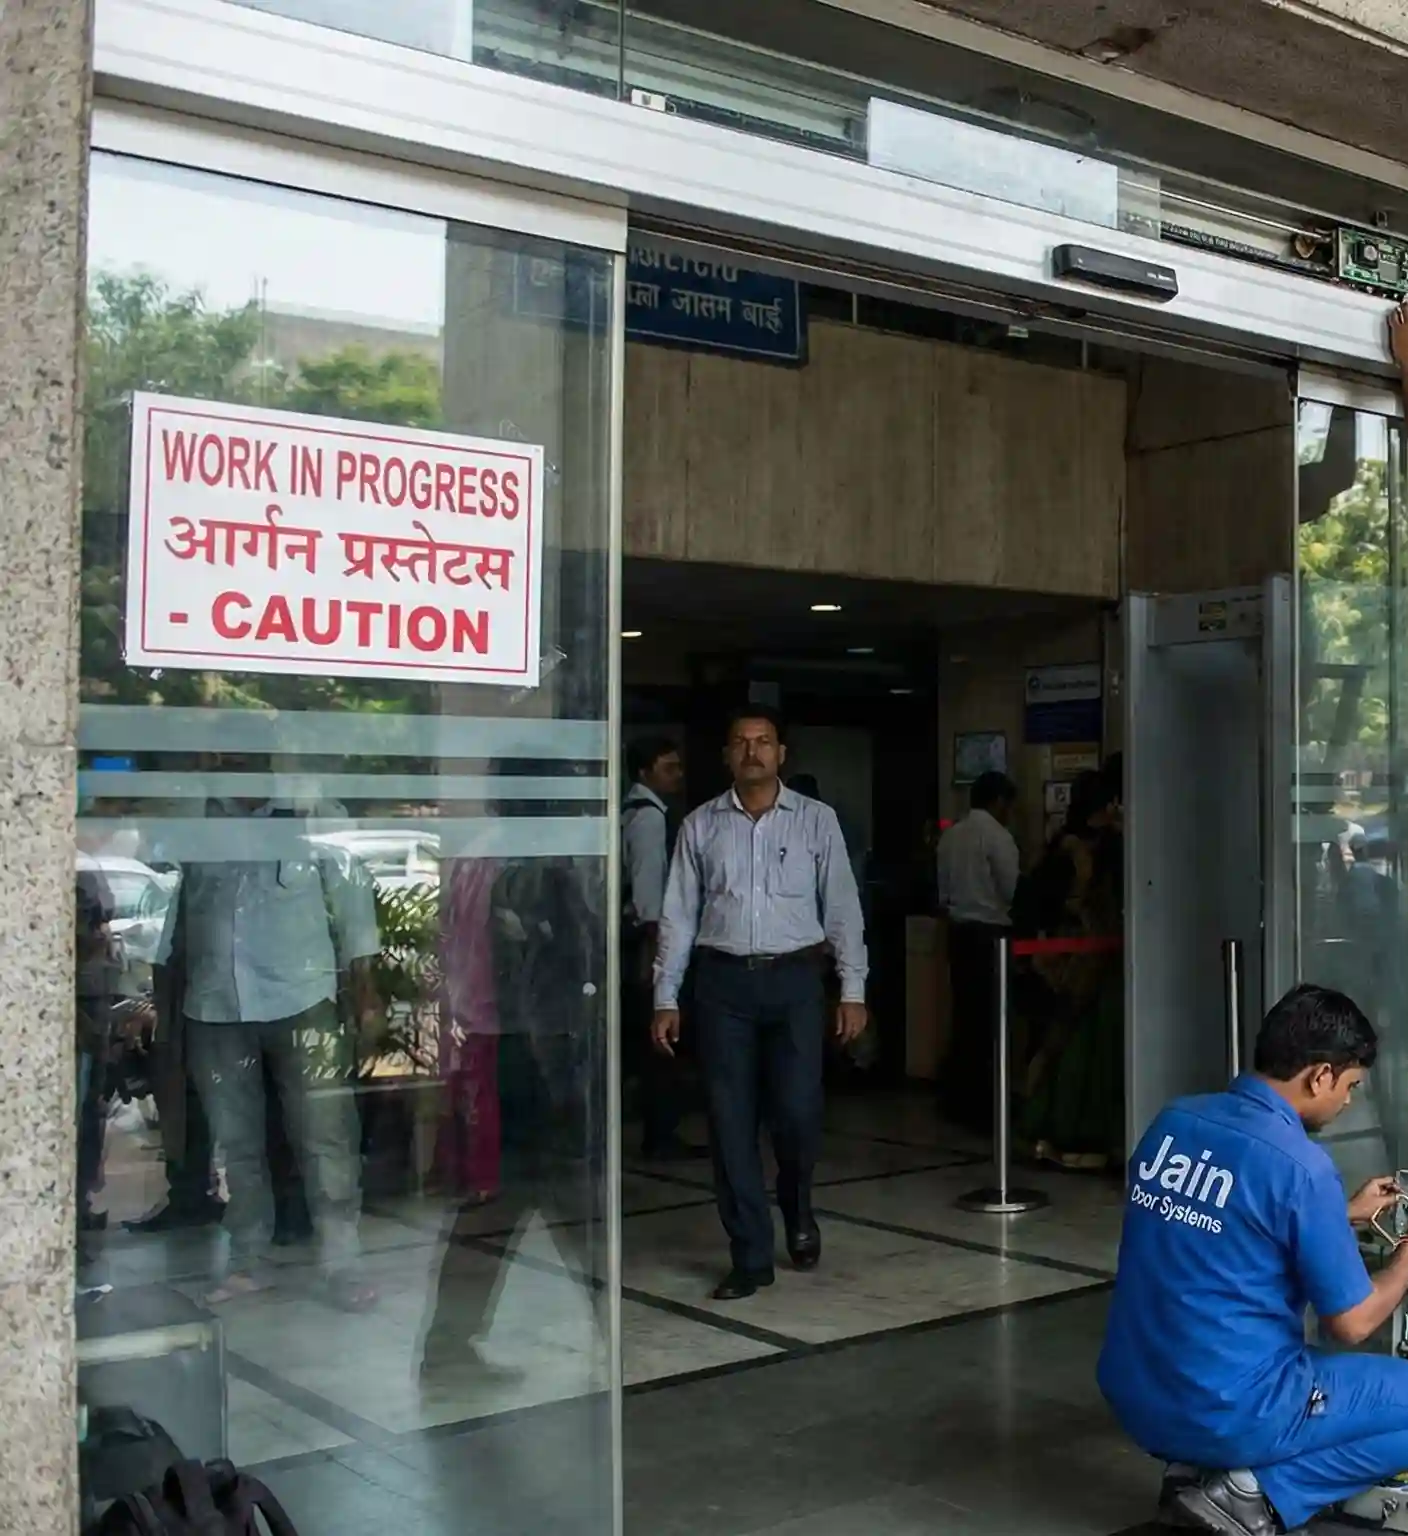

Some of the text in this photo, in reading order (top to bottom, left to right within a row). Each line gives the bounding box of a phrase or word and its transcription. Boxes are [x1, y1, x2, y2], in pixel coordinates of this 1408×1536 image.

[162, 428, 520, 520] WORK IN PROGRESS
[164, 504, 322, 574] आर्गन
[211, 591, 490, 655] CAUTION
[1139, 1134, 1233, 1209] Jain
[1131, 1184, 1223, 1234] Door Systems
